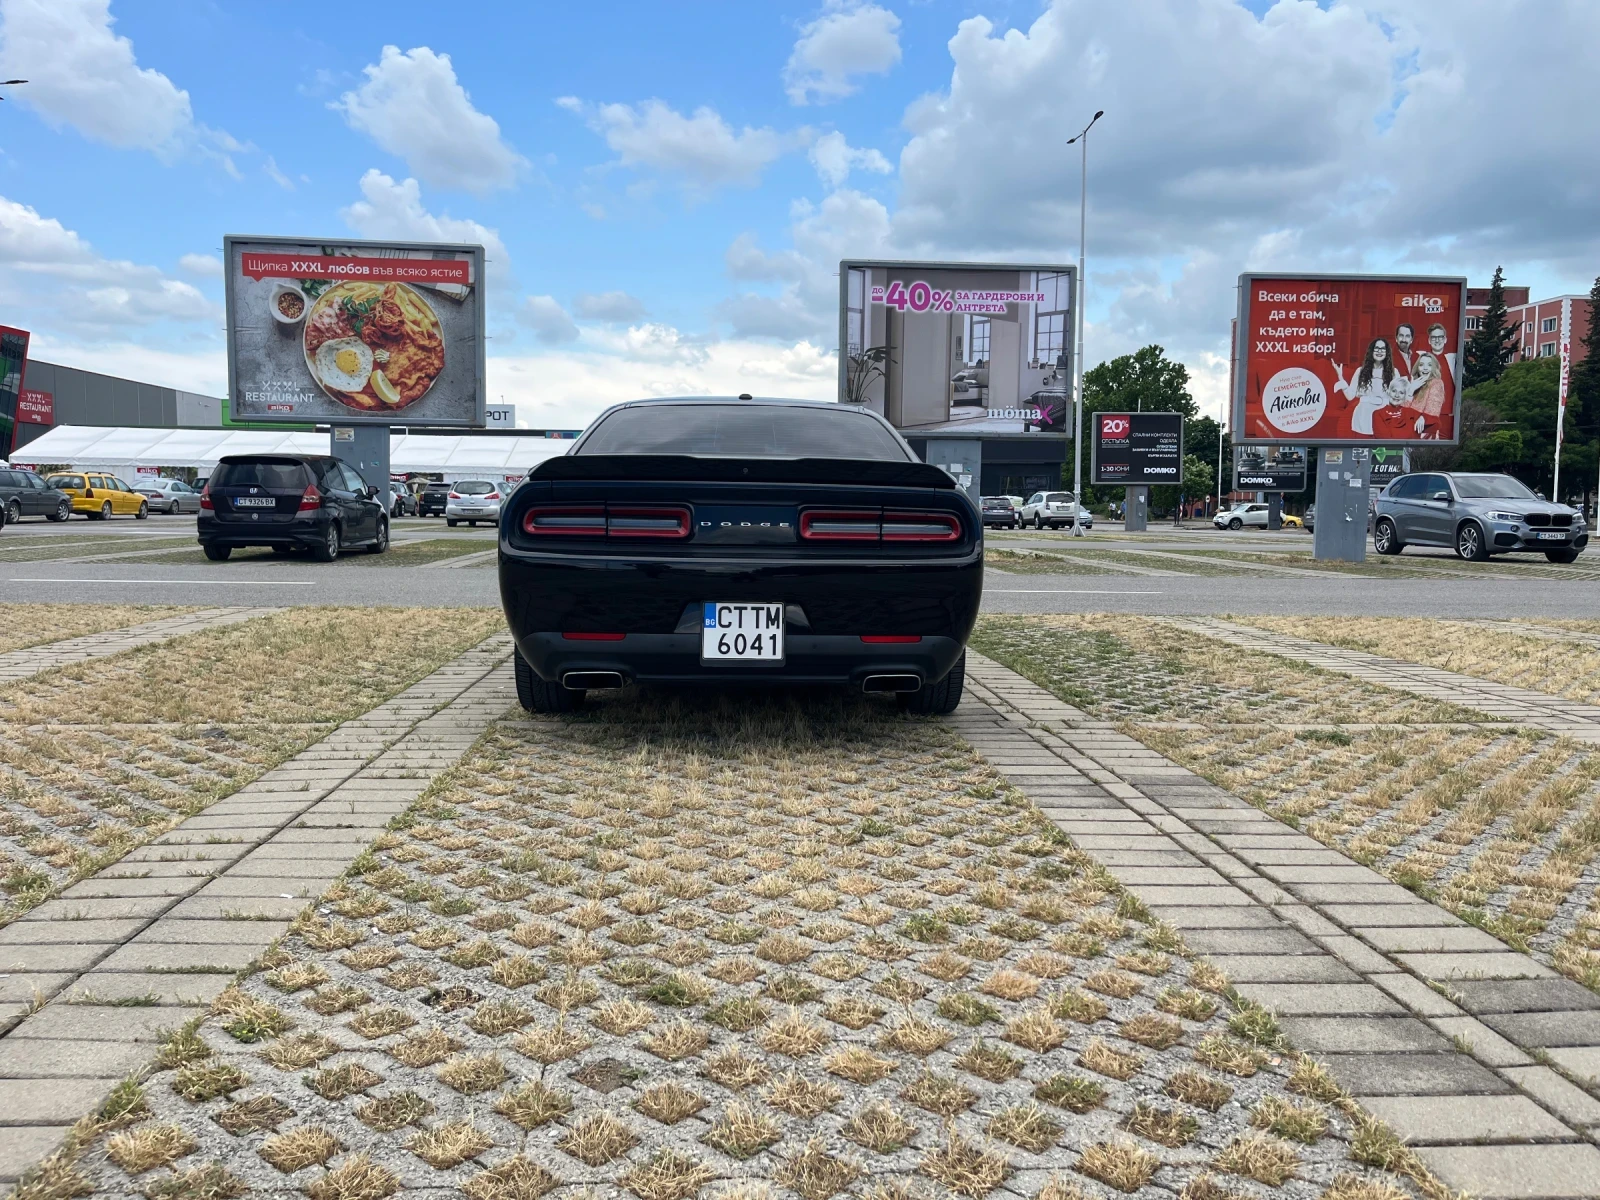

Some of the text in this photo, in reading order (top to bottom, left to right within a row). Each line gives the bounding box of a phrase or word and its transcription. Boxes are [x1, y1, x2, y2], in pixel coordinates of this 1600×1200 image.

[248, 259, 463, 278] Щипка XXXL любов във всяко ястие
[956, 292, 970, 300] ЗА
[972, 292, 1034, 302] ГАРДЕРОБИ
[1258, 290, 1339, 303] Всеки обича
[1401, 294, 1442, 307] aiko
[956, 303, 1006, 312] АНТРЕТА
[1269, 310, 1326, 321] да е там,
[1259, 327, 1335, 338] където има
[1256, 341, 1336, 356] XXXL избор!
[1273, 380, 1311, 393] СЕМЕЙСТВО
[245, 391, 315, 403] RESTAURANT
[1270, 388, 1321, 413] Айкови
[20, 401, 52, 413] RESTAURANT
[1103, 419, 1129, 433] 20%
[238, 498, 247, 506] CT
[249, 498, 265, 506] 9326
[705, 605, 781, 630] BG CTTM
[717, 632, 777, 656] 6041
